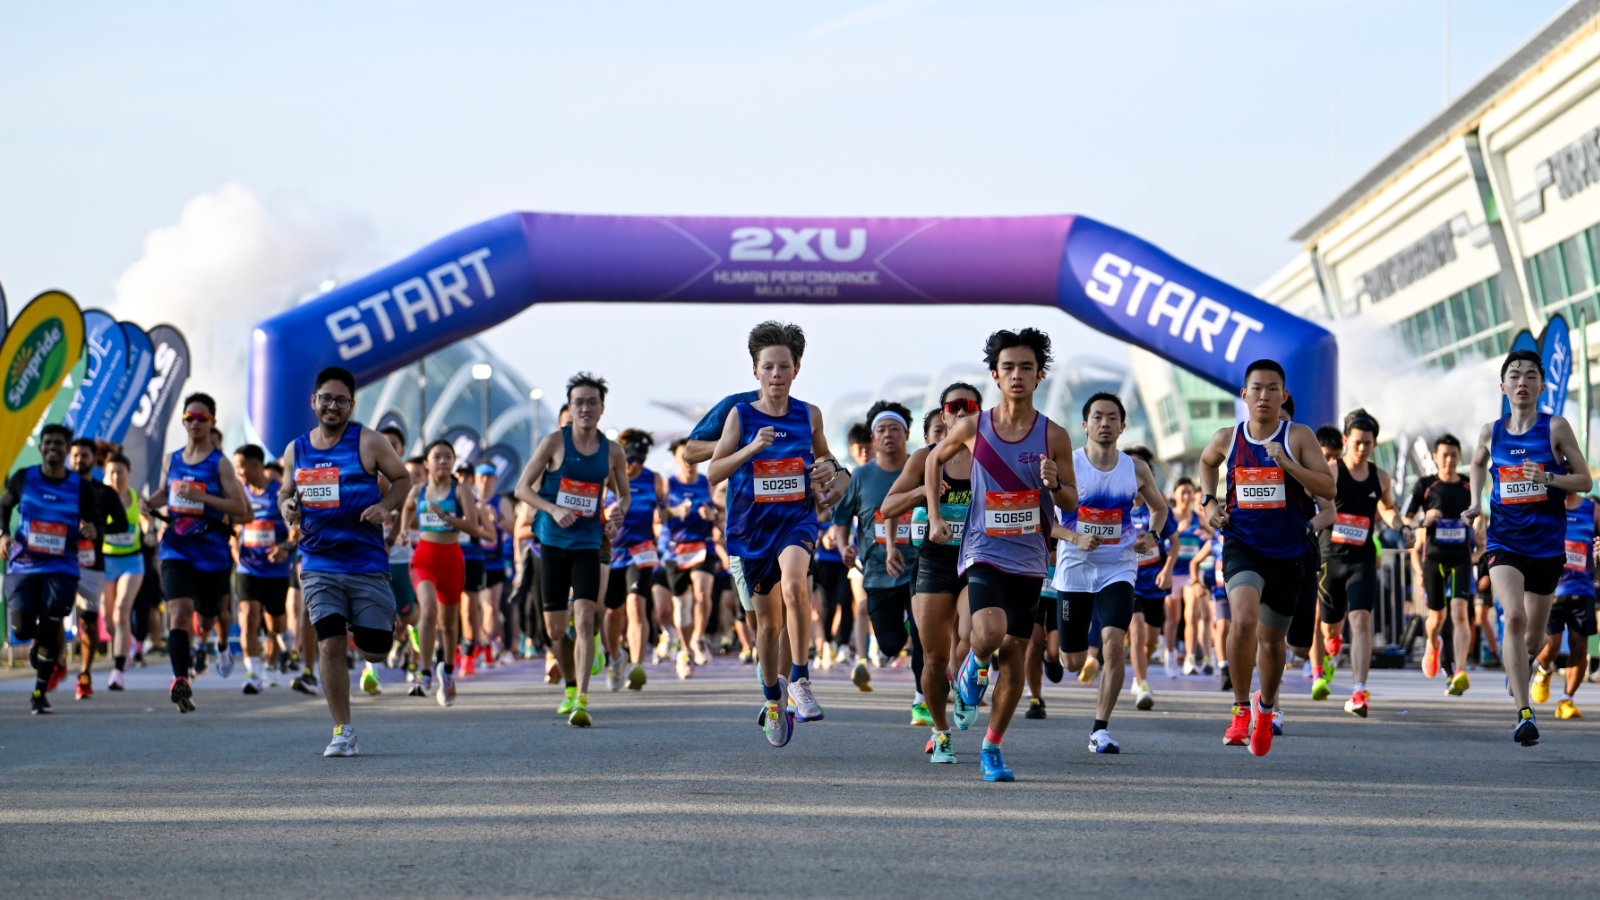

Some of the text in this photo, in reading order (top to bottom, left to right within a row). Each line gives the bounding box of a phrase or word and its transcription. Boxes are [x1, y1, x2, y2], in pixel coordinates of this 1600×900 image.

[730, 226, 868, 262] 2XU
[713, 270, 880, 285] HUMAN PERFORMANCE
[325, 246, 496, 361] START
[1084, 252, 1265, 363] START
[8, 325, 62, 408] Sunpride
[762, 478, 798, 490] 50295
[1506, 482, 1539, 493] 50376
[302, 487, 332, 497] 50635
[1243, 487, 1277, 497] 50657
[564, 495, 592, 508] 50513
[994, 511, 1033, 524] 50658
[1084, 525, 1114, 536] 50178
